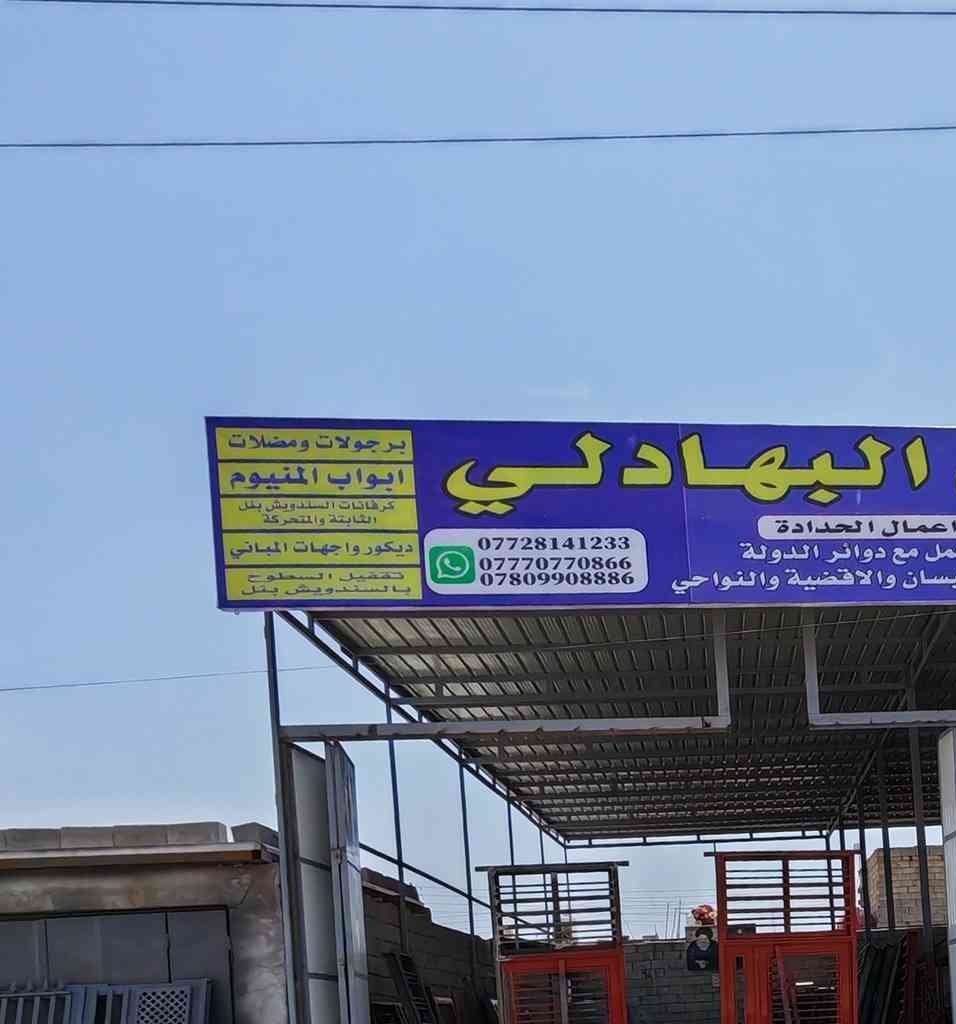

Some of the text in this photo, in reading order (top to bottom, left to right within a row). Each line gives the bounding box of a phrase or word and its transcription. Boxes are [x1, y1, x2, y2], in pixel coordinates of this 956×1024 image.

[228, 433, 406, 454] برجولات ومضلات
[230, 466, 404, 491] ابواب المنيوم
[444, 432, 929, 516] البهادلي
[775, 519, 874, 534] الحدادة
[881, 519, 956, 537] اعمال
[230, 541, 414, 560] ديكور واجهات المباني
[478, 536, 631, 551] 07728141233
[738, 542, 819, 564] الدولة
[825, 543, 887, 563] دوائر
[479, 556, 632, 571] 07770770866
[892, 547, 918, 565] مع
[479, 571, 635, 586] 07809908886
[671, 571, 780, 594] والنواحي
[784, 568, 897, 591] والاقضية
